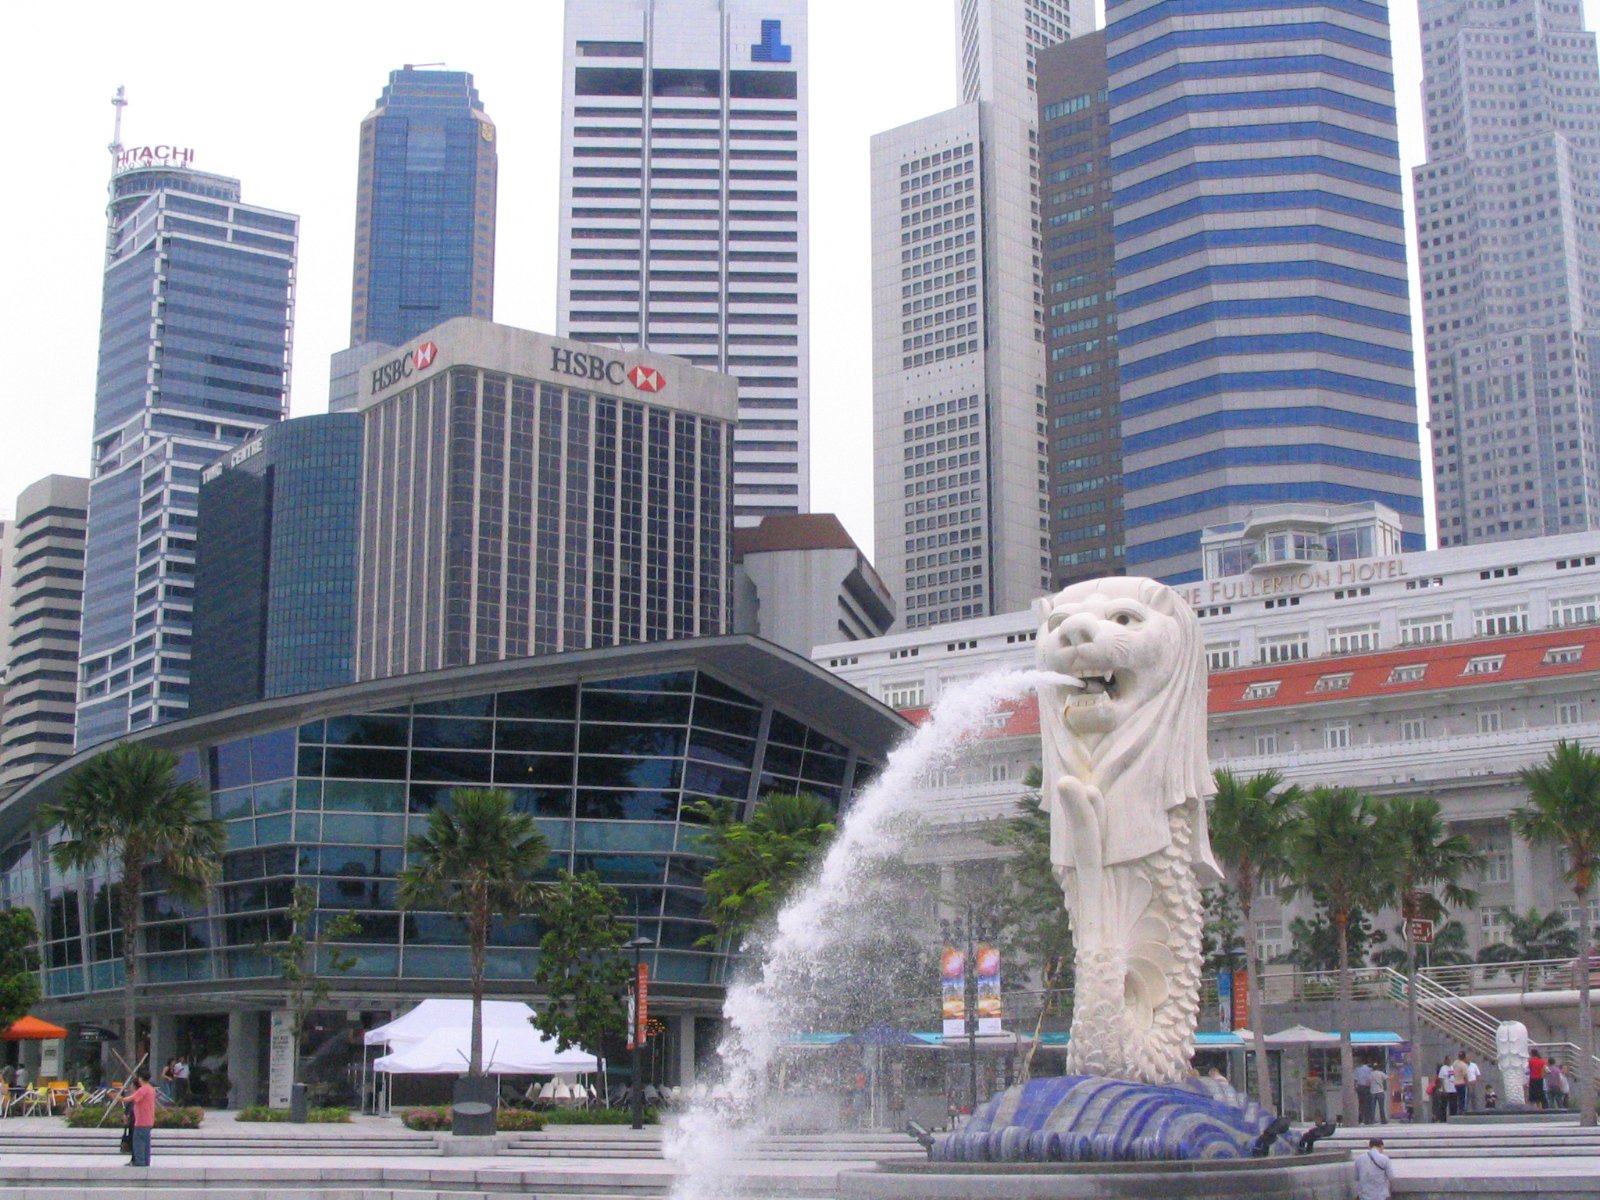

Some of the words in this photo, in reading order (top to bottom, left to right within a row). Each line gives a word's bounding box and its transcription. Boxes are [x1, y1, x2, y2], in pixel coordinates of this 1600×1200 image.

[115, 144, 194, 168] HITACHI
[371, 350, 413, 395] HSBC
[550, 346, 625, 386] HSBC
[1209, 569, 1330, 602] FULLERTON
[1337, 560, 1409, 585] HOTEL
